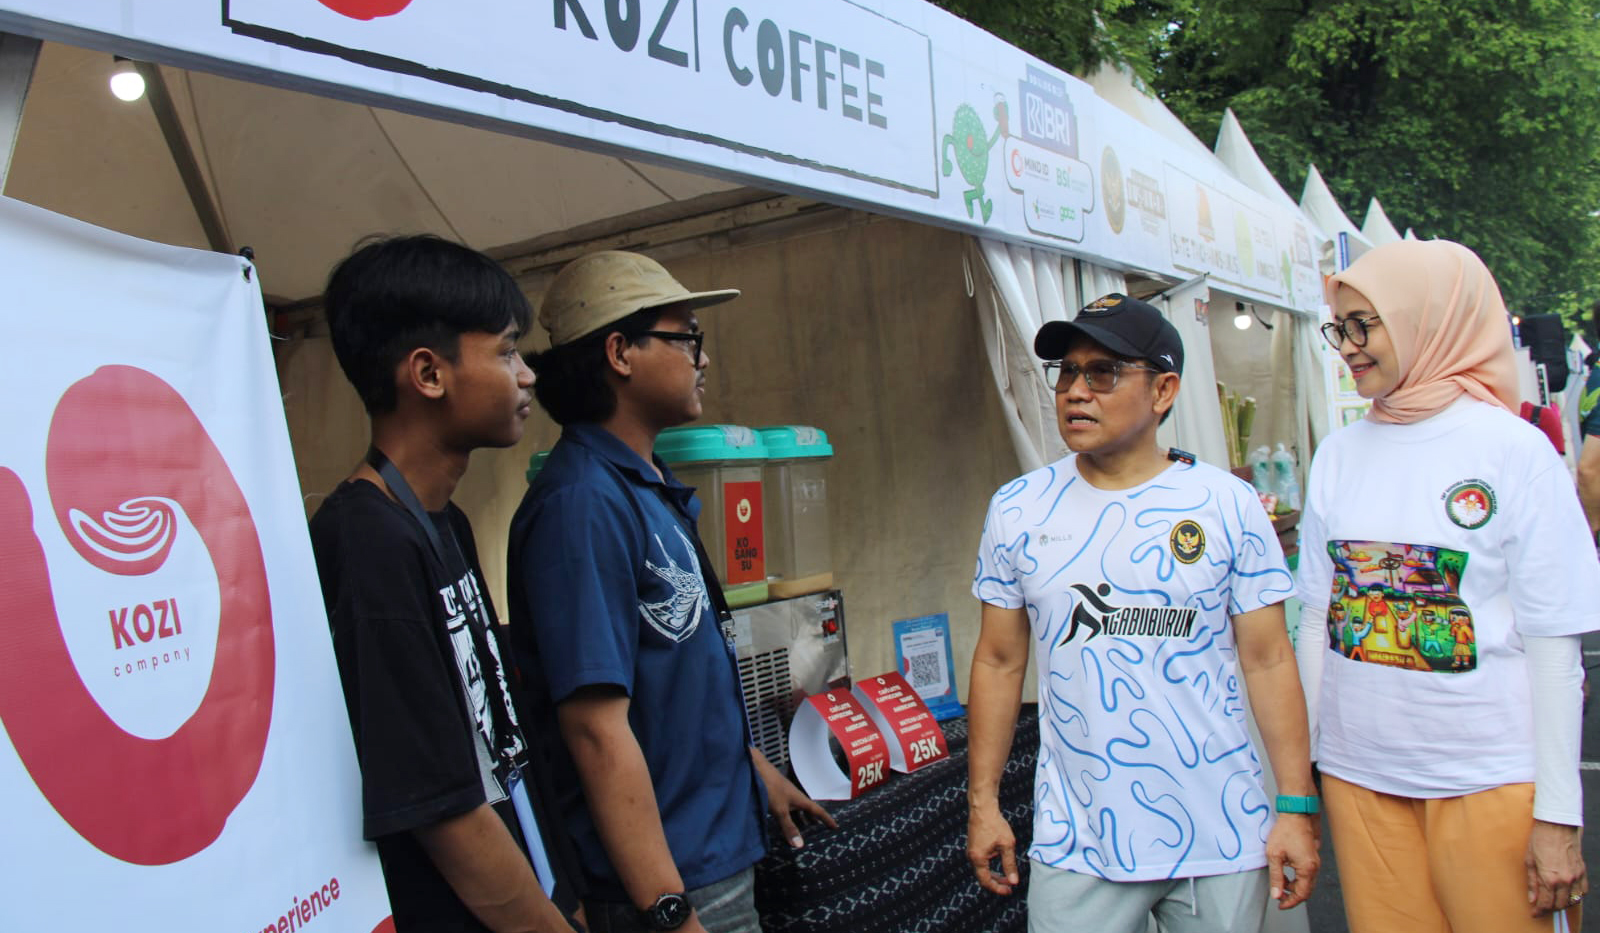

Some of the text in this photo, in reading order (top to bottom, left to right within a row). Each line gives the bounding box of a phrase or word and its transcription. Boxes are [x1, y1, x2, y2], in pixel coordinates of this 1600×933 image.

[723, 6, 888, 130] COFFEE
[1044, 102, 1071, 147] BRI
[1024, 156, 1042, 174] MIND
[736, 537, 749, 548] KO
[741, 560, 752, 571] SU
[108, 597, 182, 650] KOZI
[1101, 607, 1198, 638] NGABUBURUN
[114, 646, 190, 677] company
[909, 736, 942, 764] 25K
[857, 759, 885, 790] 25K
